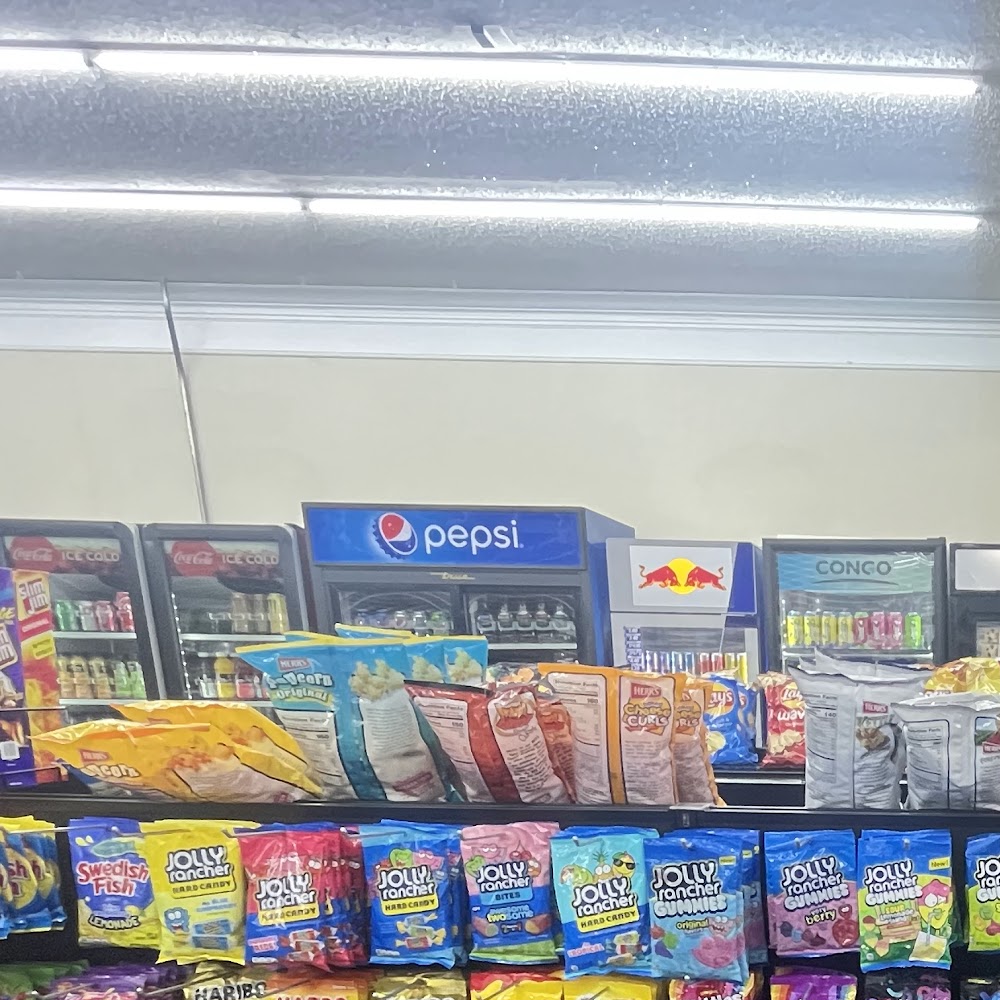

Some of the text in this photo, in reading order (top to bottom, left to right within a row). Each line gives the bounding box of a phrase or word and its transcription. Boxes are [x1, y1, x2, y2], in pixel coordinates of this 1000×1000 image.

[423, 520, 519, 555] pepsi
[62, 552, 120, 562] ICE COLD
[222, 554, 279, 565] ICE COLD
[627, 716, 670, 728] CURLS
[165, 846, 225, 872] JOLLY
[76, 860, 149, 884] Swedish
[169, 864, 231, 883] rancher
[378, 865, 433, 889] JOLLY
[476, 862, 526, 884] JOLLY
[652, 861, 718, 890] JOLLY
[782, 856, 837, 888] JOLLY
[93, 877, 135, 897] Fish
[256, 872, 312, 900] JOLLY
[382, 882, 435, 900] rancher
[480, 876, 530, 892] rancher
[572, 876, 630, 908] JOLLY
[658, 882, 722, 902] rancher
[787, 874, 844, 895] rancher
[260, 891, 316, 910] rancher
[384, 898, 436, 912] HARD CANDY
[577, 896, 636, 918] rancher
[653, 896, 728, 918] GUMMIES
[784, 884, 849, 910] GUMMIES
[865, 888, 924, 906] GUMMIES
[89, 915, 141, 930] LEMONADE
[581, 910, 637, 928] HARD CANDY
[805, 910, 836, 926] berry
